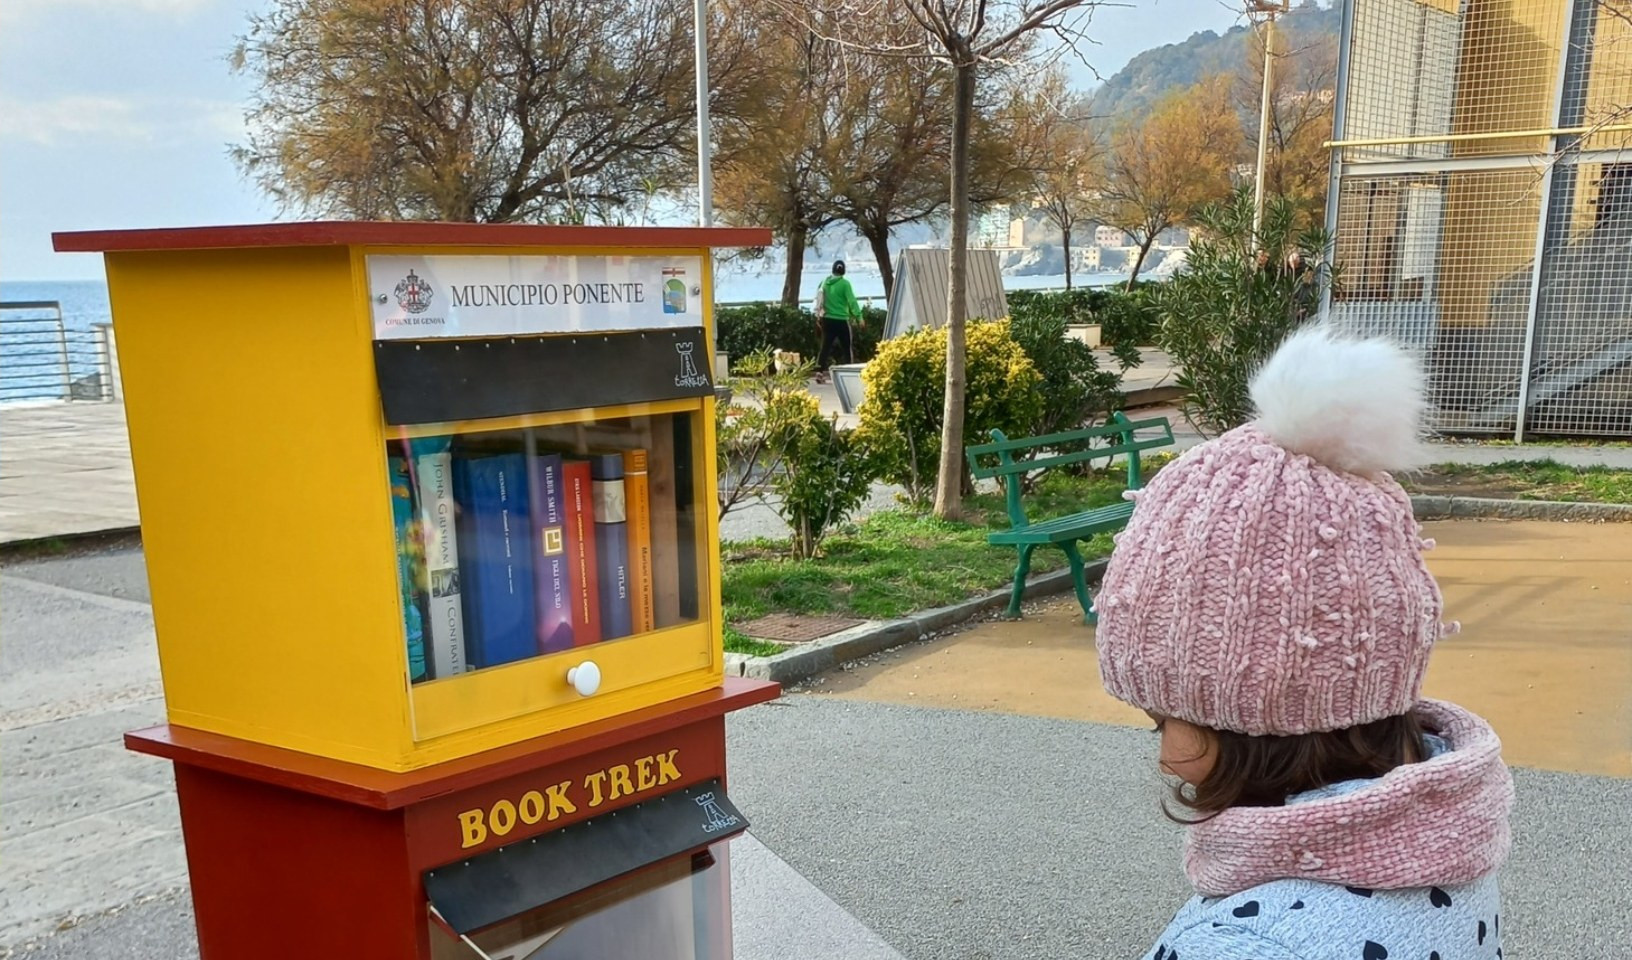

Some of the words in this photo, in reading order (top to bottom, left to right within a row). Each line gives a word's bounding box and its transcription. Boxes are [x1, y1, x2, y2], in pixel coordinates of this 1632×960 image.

[450, 283, 558, 308] MUNICIPIO
[563, 282, 645, 306] PONENTE
[433, 463, 445, 500] JOHN
[546, 465, 555, 495] WILBUR
[547, 497, 557, 523] SMITH
[617, 565, 626, 600] HITLER
[457, 780, 577, 849] BOOK
[583, 749, 683, 807] TREK
